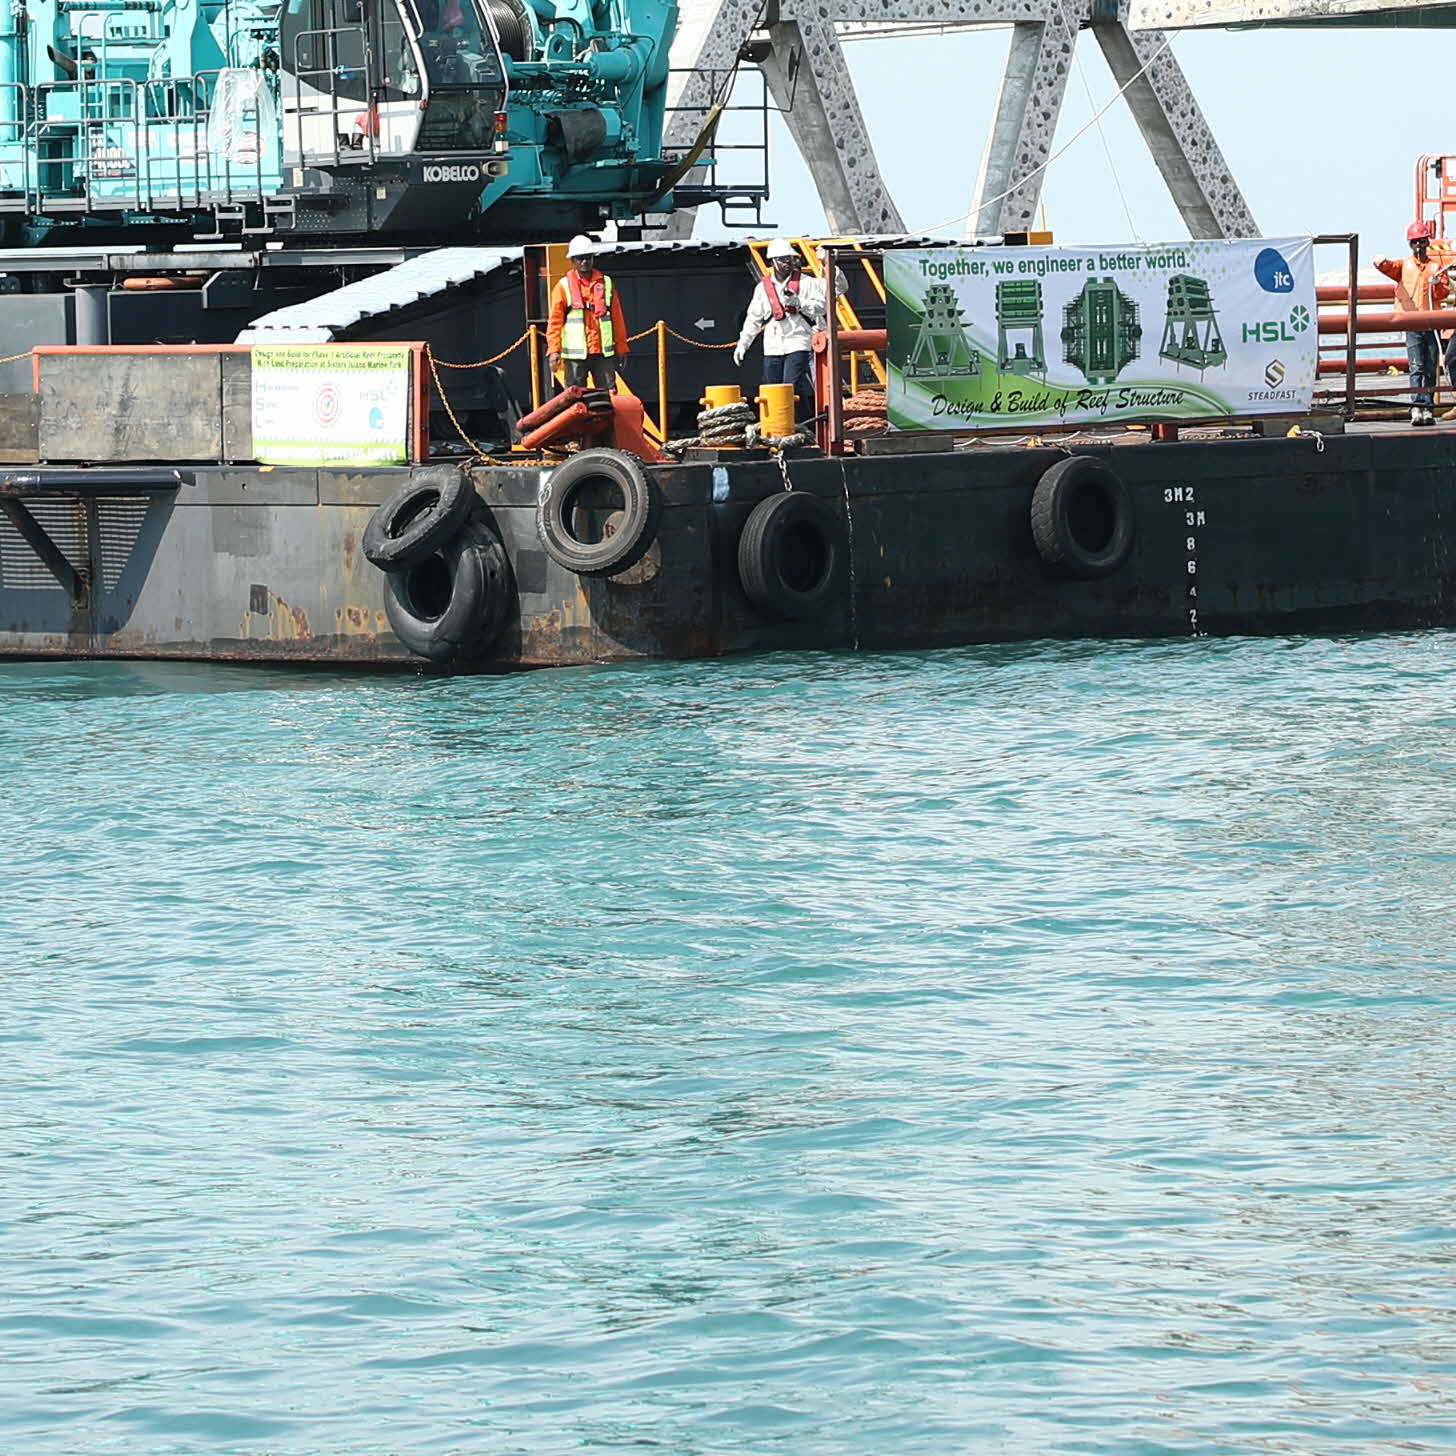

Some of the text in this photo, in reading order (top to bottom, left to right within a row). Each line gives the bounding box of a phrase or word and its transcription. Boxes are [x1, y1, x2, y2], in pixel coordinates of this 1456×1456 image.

[423, 165, 480, 183] KOBELCO
[919, 251, 1191, 281] Together, we engineer a better world.
[1273, 272, 1291, 288] jtc
[1242, 321, 1296, 343] HSL
[1248, 390, 1297, 401] STEADFAST
[931, 387, 1184, 421] Design & Build of Reef Structure
[1186, 537, 1195, 551] 8
[1187, 560, 1196, 574] 6
[1189, 609, 1197, 623] 2
